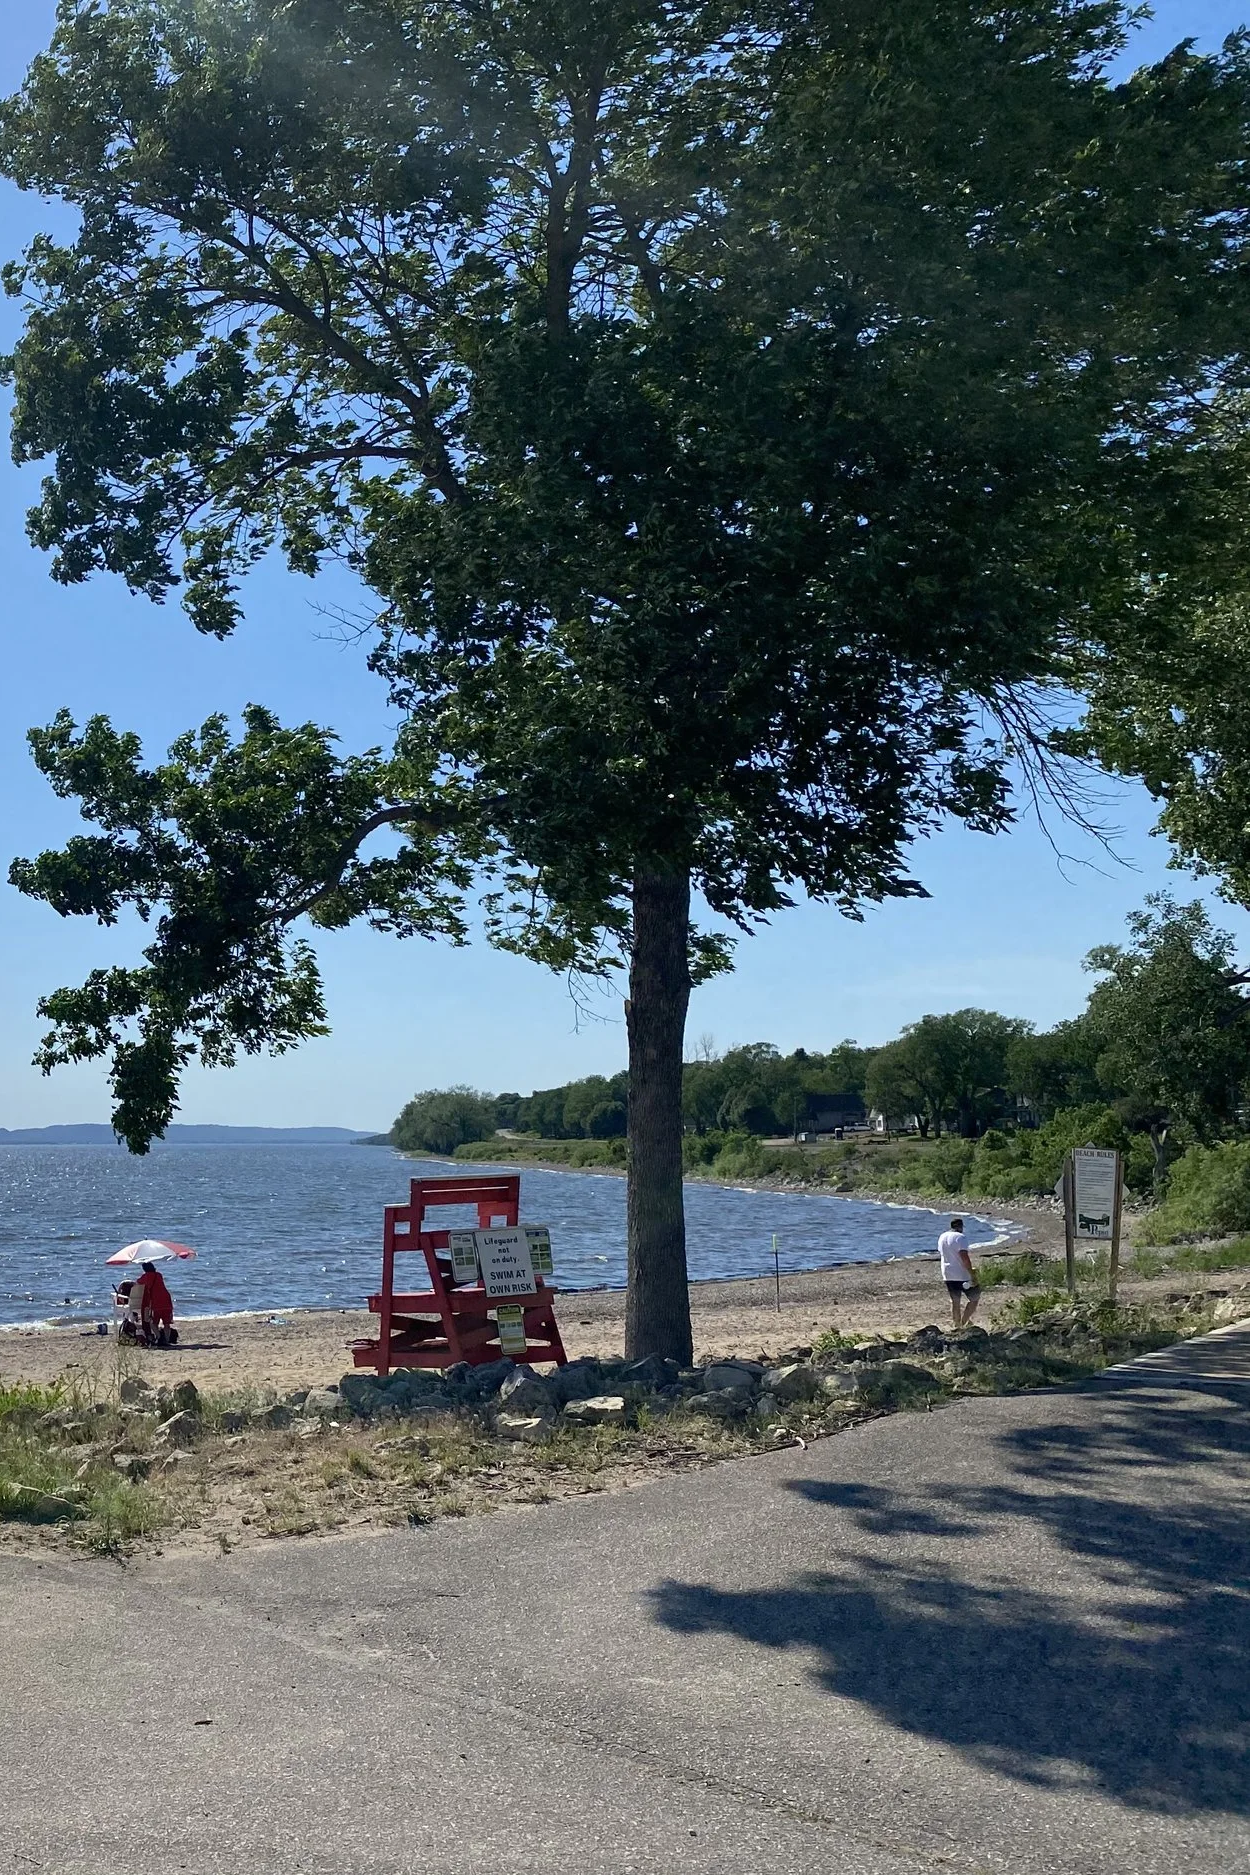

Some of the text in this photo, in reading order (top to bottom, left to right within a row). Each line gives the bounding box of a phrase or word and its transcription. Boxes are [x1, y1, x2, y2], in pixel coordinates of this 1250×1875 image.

[483, 1236, 518, 1246] Lifeguard
[490, 1269, 526, 1280] SWIM AT
[489, 1283, 533, 1294] OWN RISK
